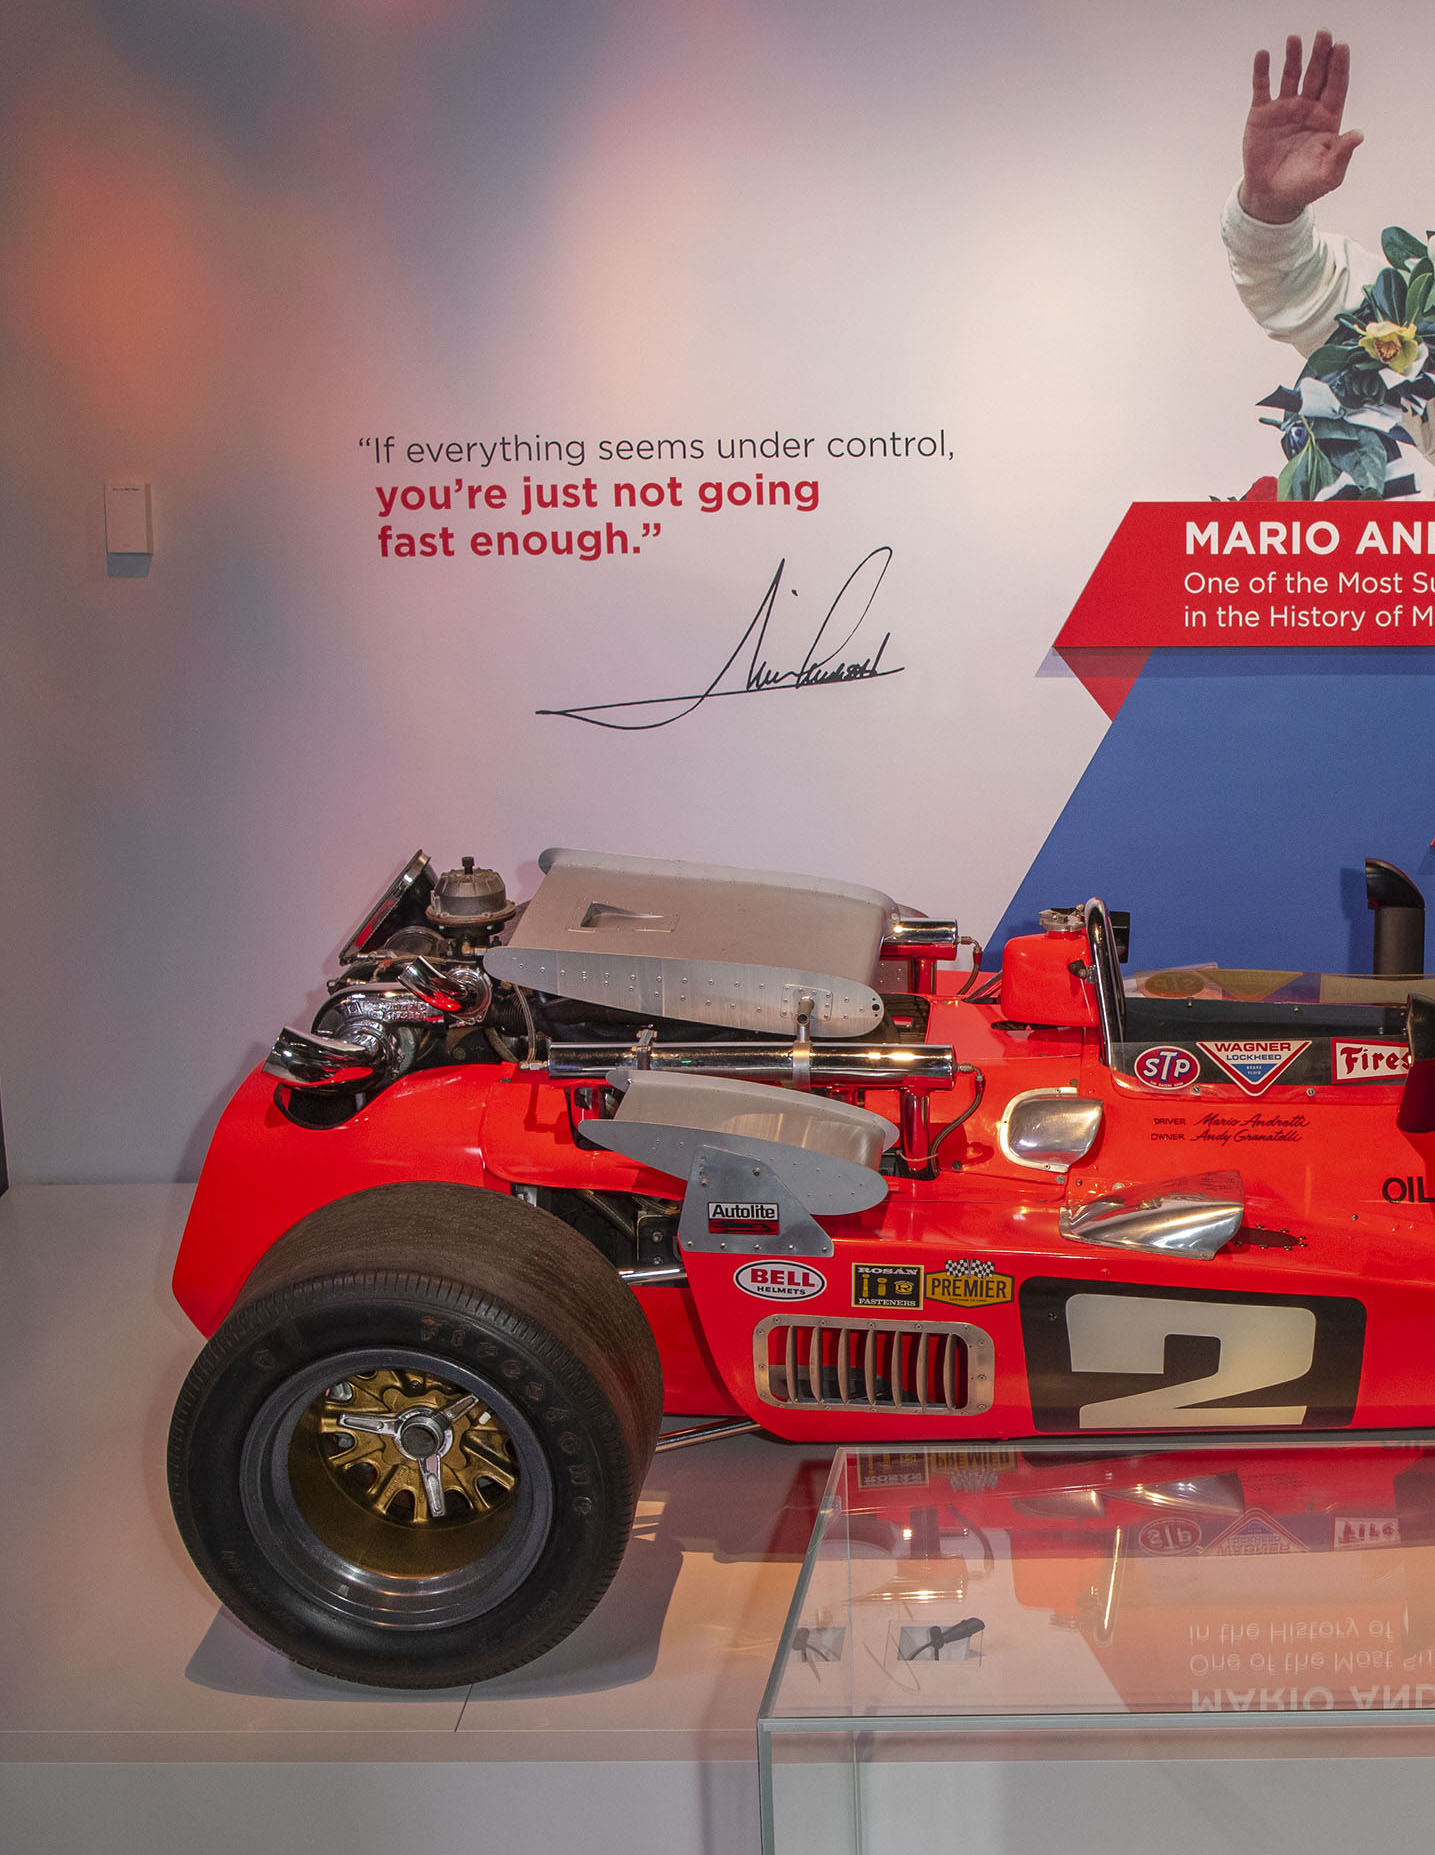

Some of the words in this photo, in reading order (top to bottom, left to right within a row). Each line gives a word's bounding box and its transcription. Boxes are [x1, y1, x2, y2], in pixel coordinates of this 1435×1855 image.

[406, 434, 586, 467] everything
[598, 437, 705, 461] seems
[716, 431, 815, 460] under
[826, 429, 956, 462] control,
[522, 472, 598, 515] just
[613, 477, 682, 507] not
[700, 472, 820, 513] going
[378, 526, 455, 558] fast
[1185, 521, 1339, 555] MARIO
[1185, 572, 1240, 593] One
[1249, 571, 1277, 593] of
[1285, 571, 1328, 593] the
[1339, 572, 1403, 593] Most
[1185, 605, 1206, 627] in
[1216, 605, 1260, 627] the
[1271, 605, 1365, 631] History
[1376, 605, 1403, 627] of
[1215, 1043, 1291, 1052] WAGNER
[1143, 1051, 1190, 1081] STP
[1193, 1113, 1238, 1126] Mario
[1240, 1114, 1310, 1127] Andretti
[1190, 1129, 1232, 1146] Andy
[712, 1205, 775, 1218] Autolite
[751, 1268, 815, 1287] BELL
[931, 1278, 1006, 1298] PREMIER
[757, 1286, 806, 1295] HELMETS
[859, 1298, 916, 1306] FASTENERS
[1066, 1293, 1317, 1429] 2
